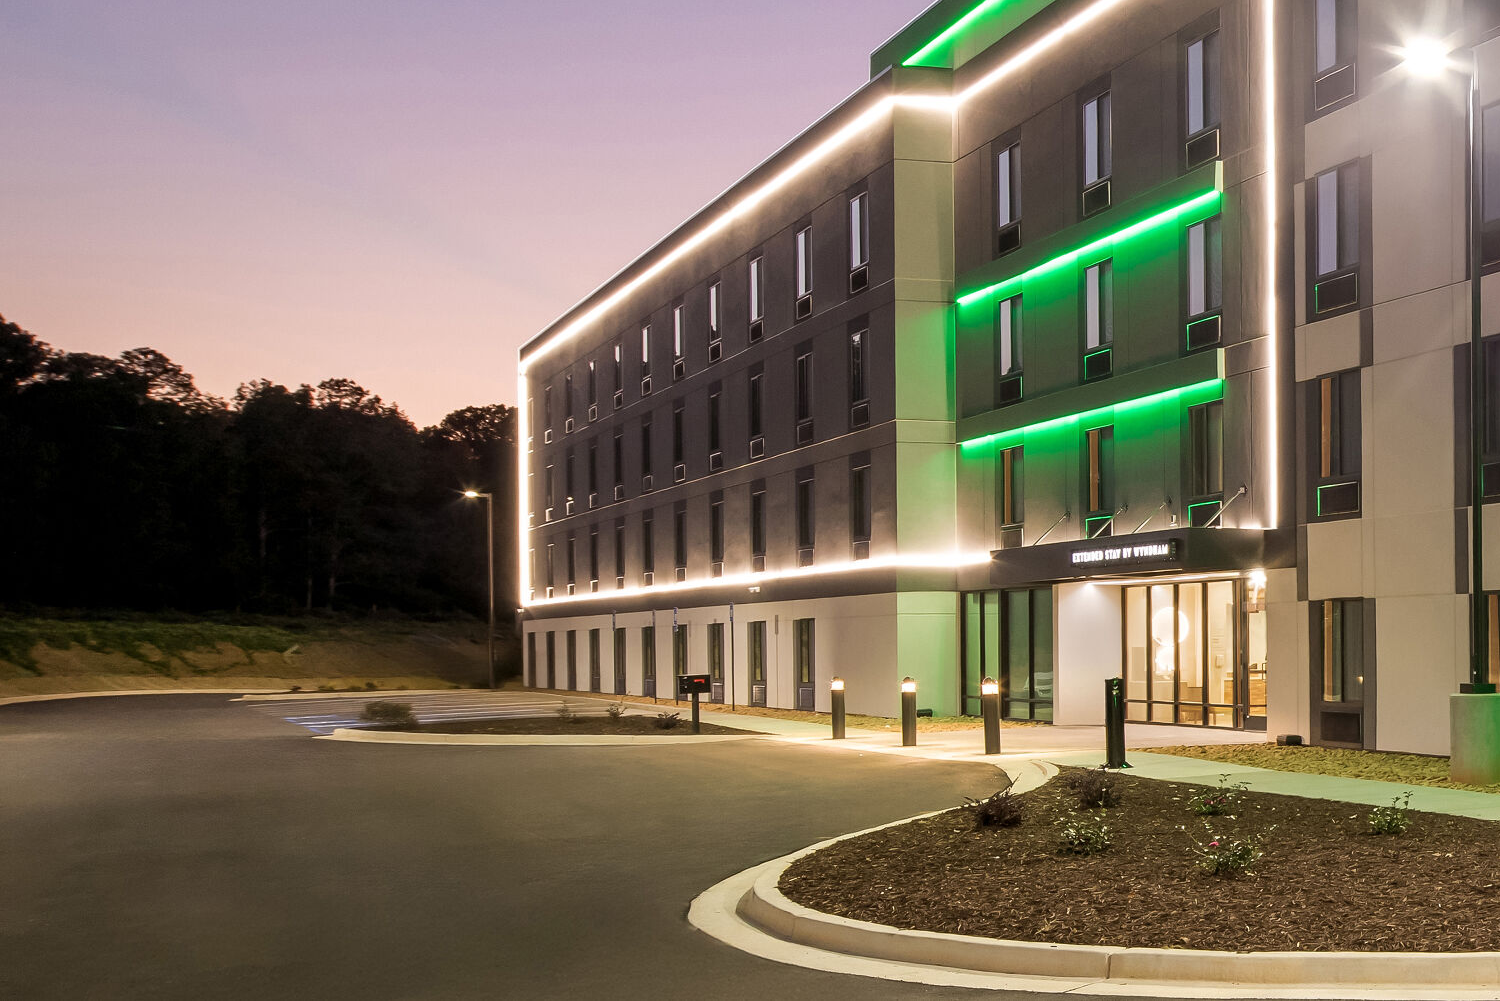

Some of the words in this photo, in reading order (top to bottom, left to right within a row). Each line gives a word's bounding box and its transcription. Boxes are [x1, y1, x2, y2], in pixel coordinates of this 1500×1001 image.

[1072, 551, 1104, 563] EXTENDED
[1105, 549, 1121, 560] STAY
[1122, 547, 1132, 559] BY
[1133, 544, 1168, 557] WYNDHAM
